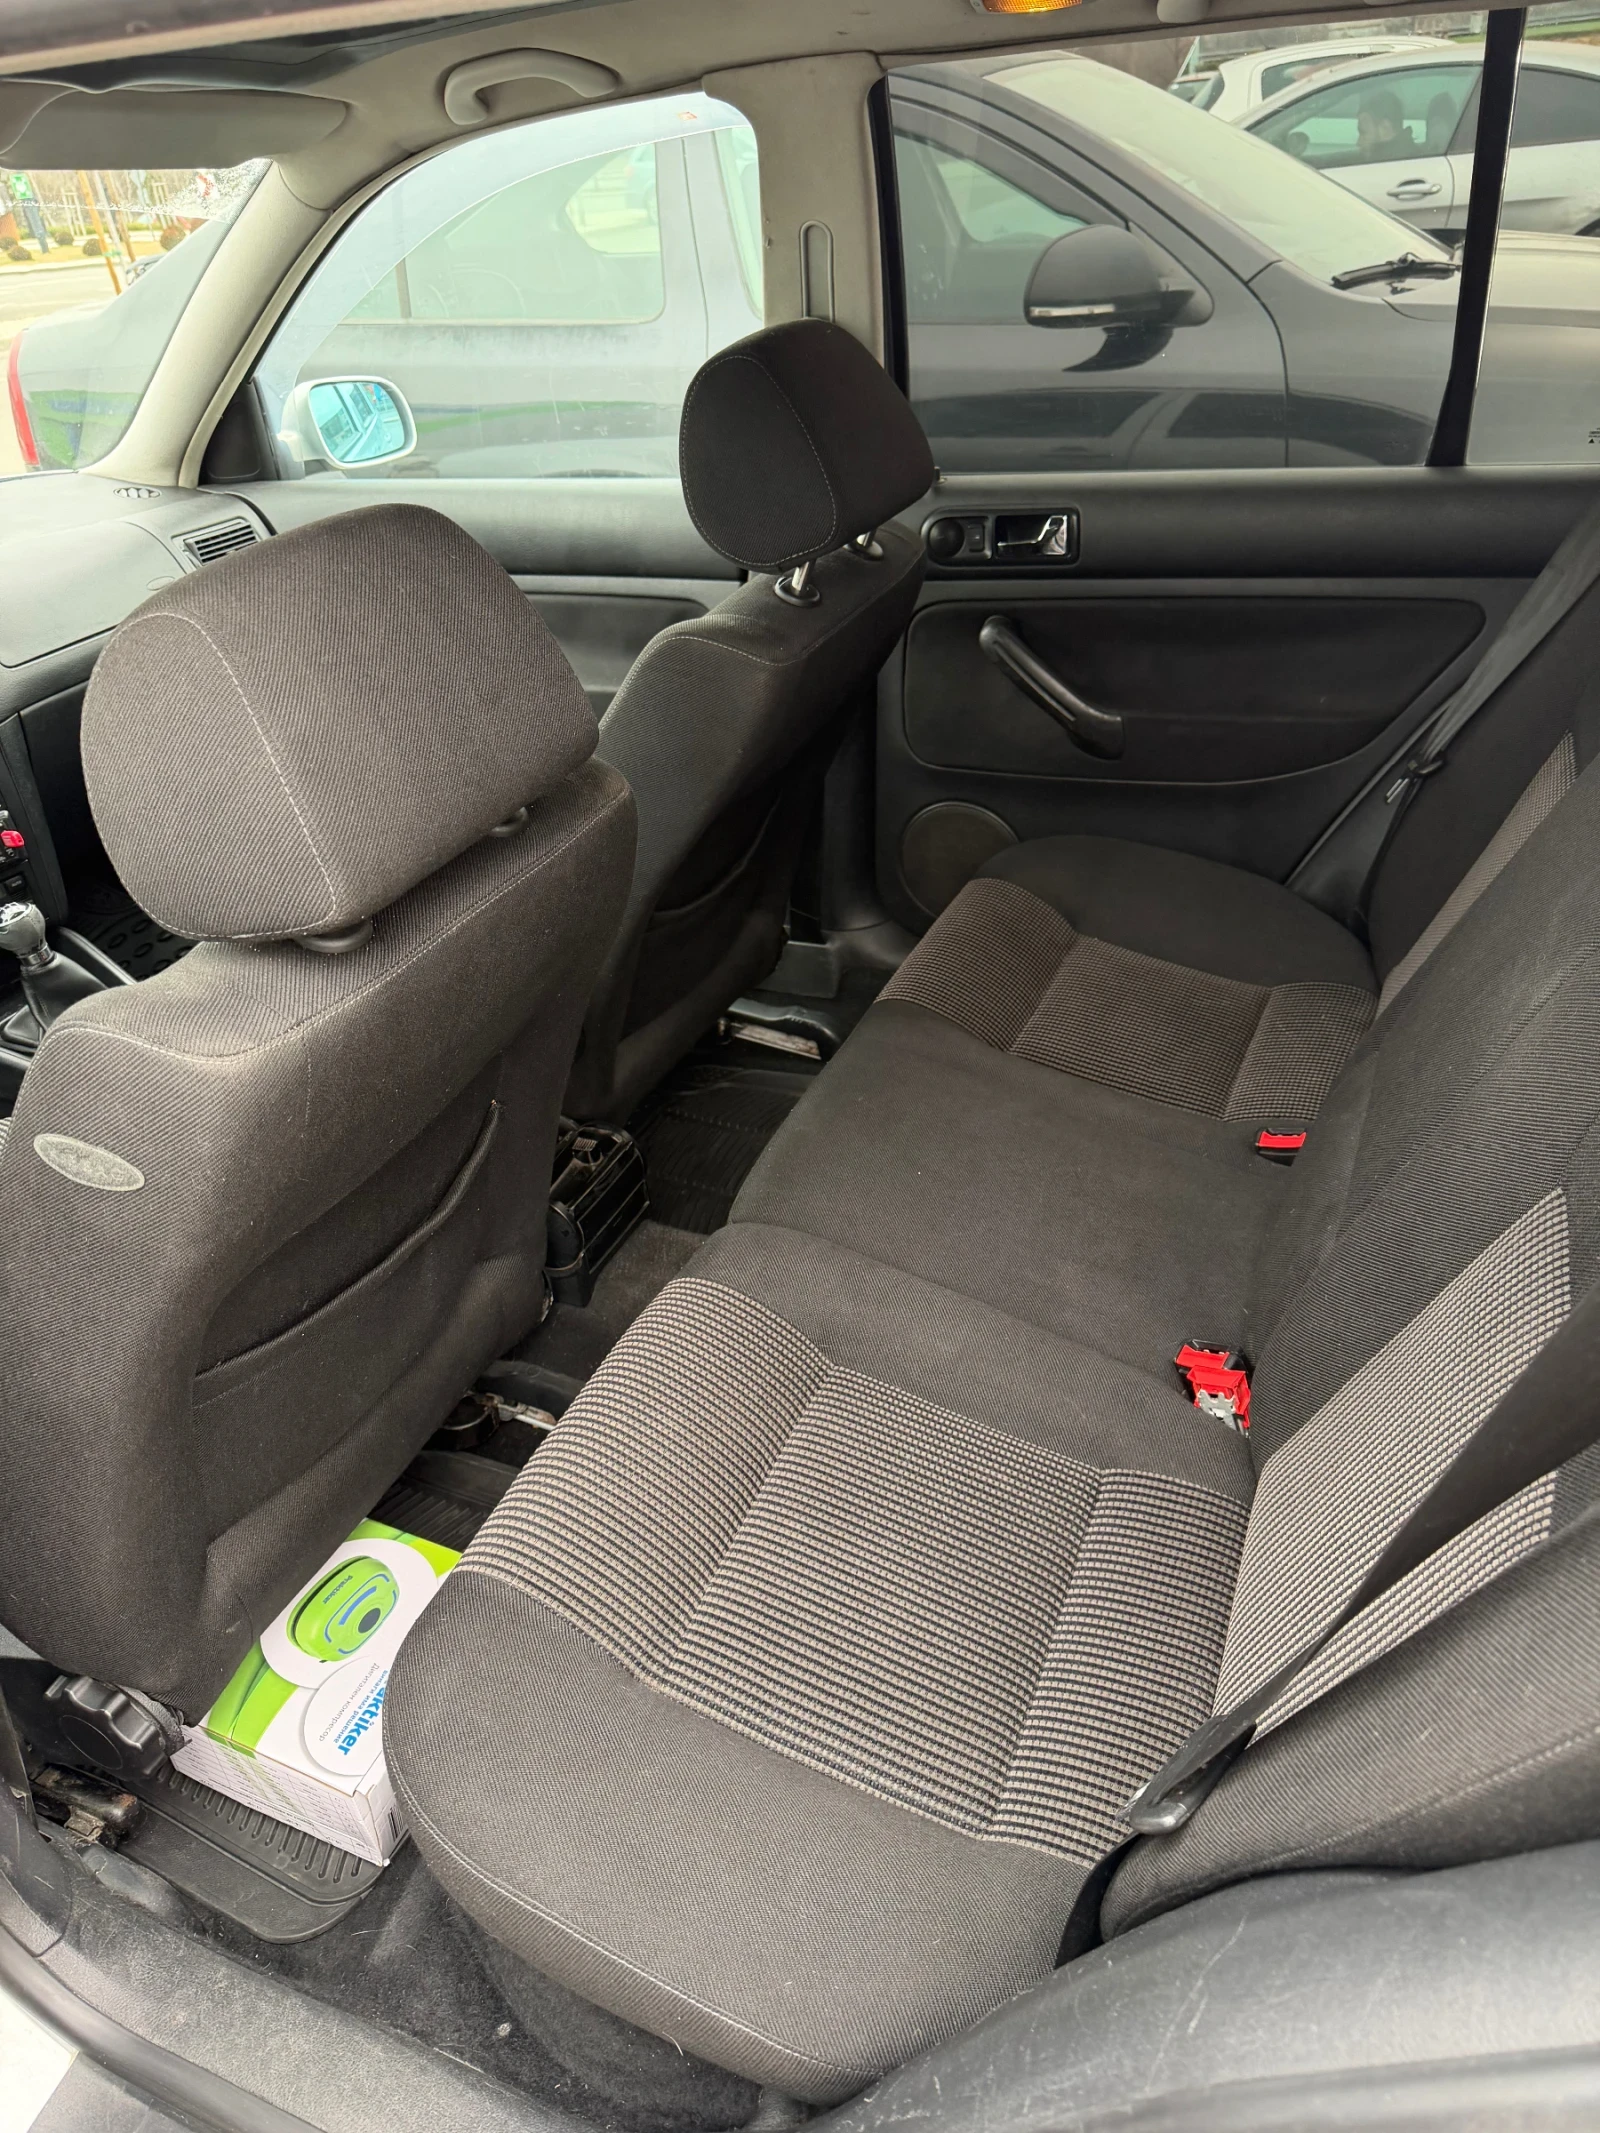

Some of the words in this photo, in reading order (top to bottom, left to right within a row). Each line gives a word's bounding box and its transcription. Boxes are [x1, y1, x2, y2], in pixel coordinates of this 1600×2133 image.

[350, 1662, 380, 1700] Дигитален
[357, 1695, 371, 1710] има
[318, 1700, 351, 1742] компресор
[333, 1710, 359, 1744] решение
